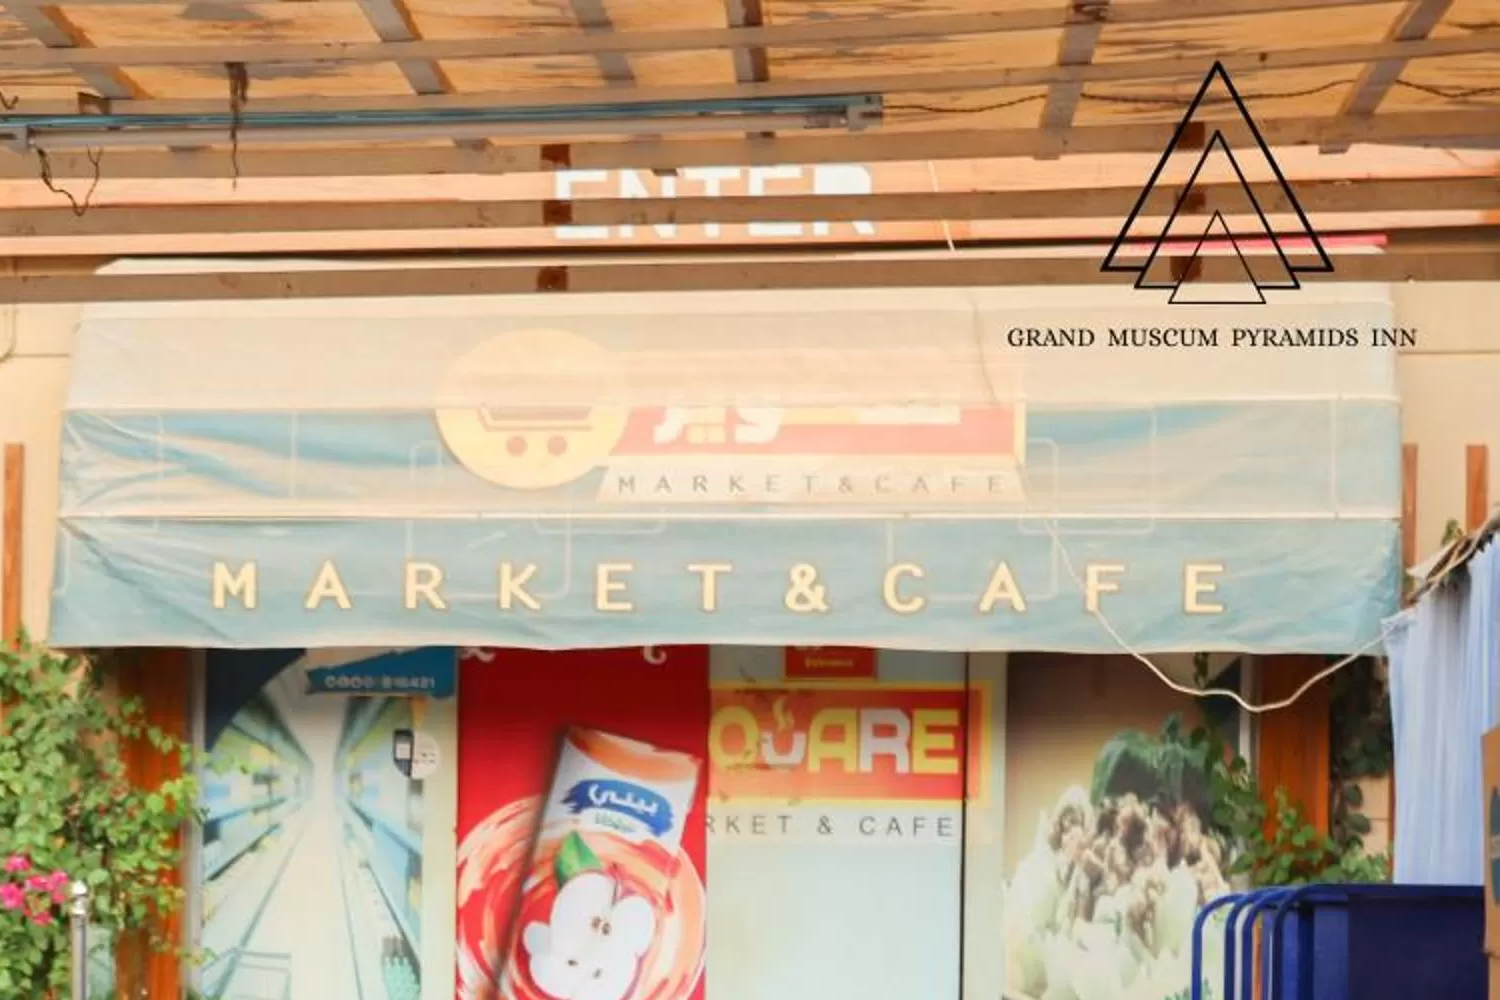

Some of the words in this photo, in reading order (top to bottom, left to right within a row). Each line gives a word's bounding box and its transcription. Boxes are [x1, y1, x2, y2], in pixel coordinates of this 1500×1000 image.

[554, 163, 876, 239] ENTER
[708, 700, 960, 774] QUARE
[705, 815, 792, 836] RKET
[816, 815, 833, 836] &
[858, 815, 953, 838] CAFE
